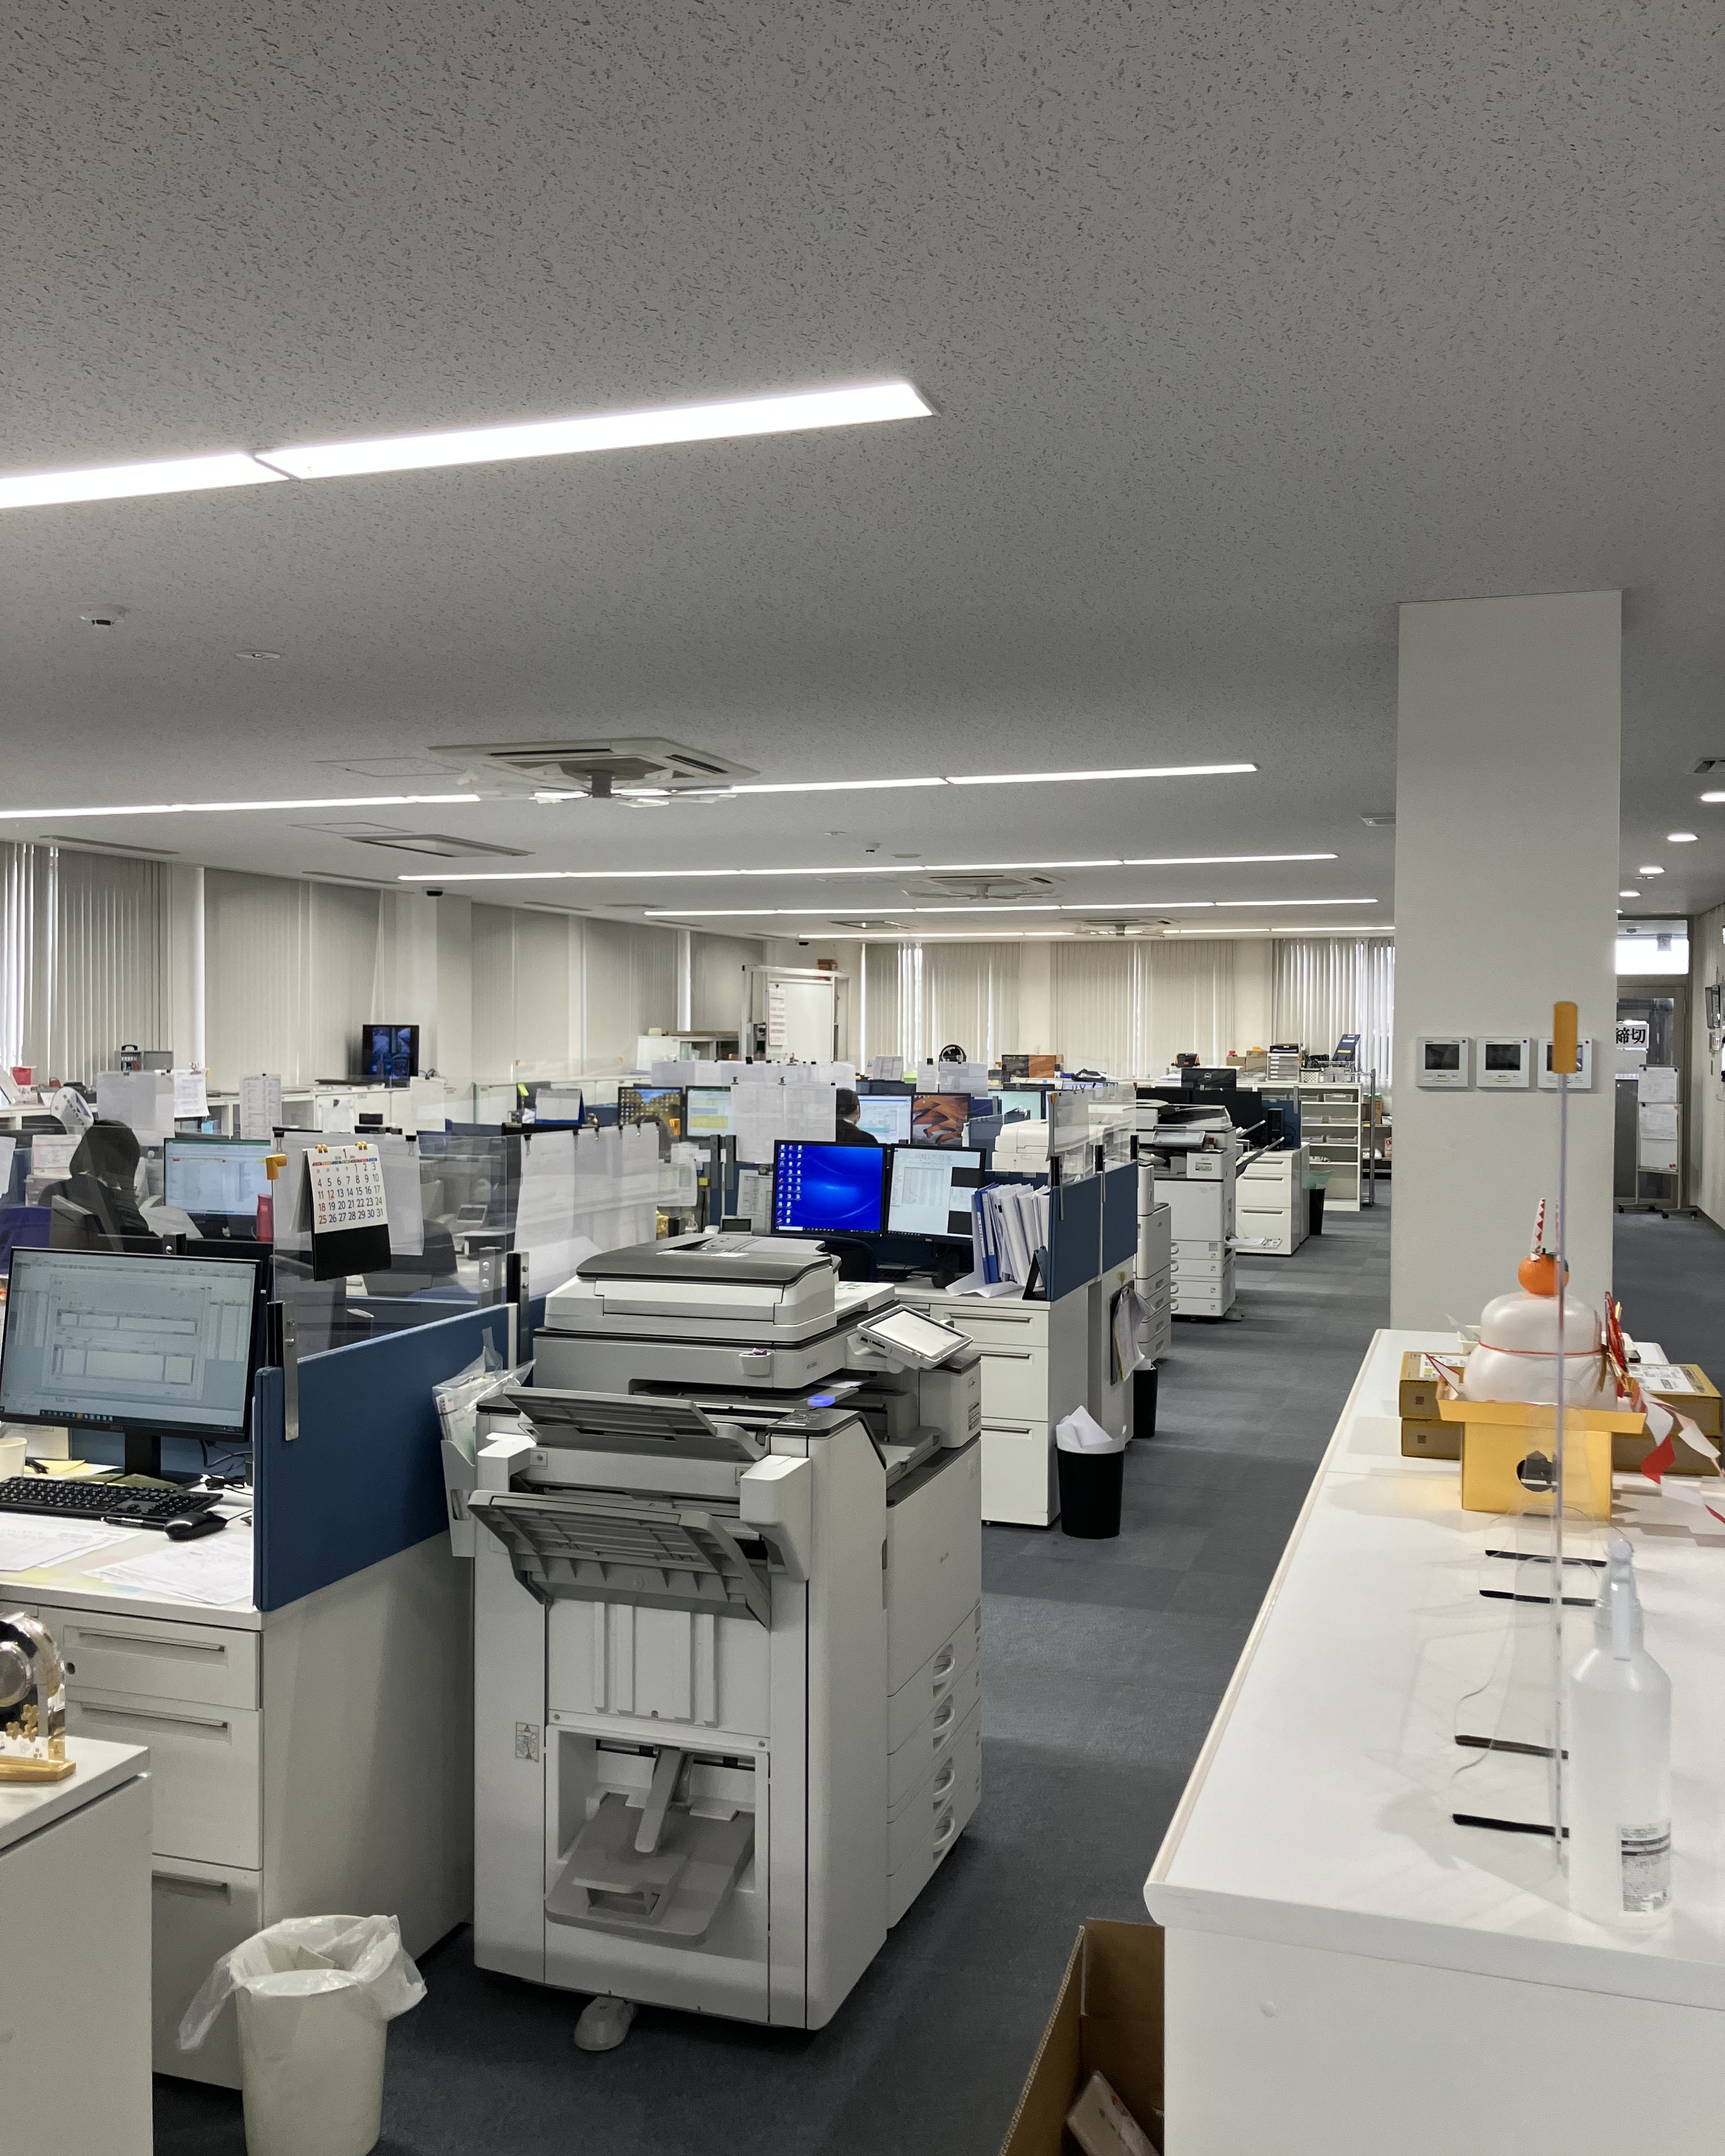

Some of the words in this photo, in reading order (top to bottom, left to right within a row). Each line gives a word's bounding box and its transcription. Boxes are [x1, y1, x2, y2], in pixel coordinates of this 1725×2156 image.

[1615, 1027, 1646, 1044] 締切
[343, 1148, 347, 1159] 1
[372, 1162, 376, 1170] 3
[318, 1178, 322, 1187] 4
[327, 1178, 331, 1186] 5
[337, 1177, 342, 1186] 6
[356, 1175, 360, 1184] 8
[365, 1174, 369, 1183] 9
[372, 1173, 379, 1182] 10
[318, 1191, 324, 1199] 11
[327, 1190, 334, 1198] 12
[337, 1189, 344, 1198] 13
[346, 1188, 353, 1197] 14
[356, 1187, 363, 1195] 15
[365, 1186, 371, 1194] 16
[374, 1185, 380, 1194] 17
[318, 1203, 326, 1212] 18
[329, 1201, 335, 1211] 19
[338, 1201, 345, 1210] 20
[347, 1199, 354, 1209] 21
[357, 1198, 365, 1207] 22
[366, 1198, 374, 1206] 23
[375, 1197, 382, 1205] 24
[319, 1215, 327, 1224] 25
[329, 1214, 337, 1223] 26
[338, 1213, 346, 1222] 27
[348, 1211, 356, 1221] 28
[358, 1210, 366, 1219] 29
[367, 1209, 375, 1218] 30
[376, 1208, 383, 1217] 31
